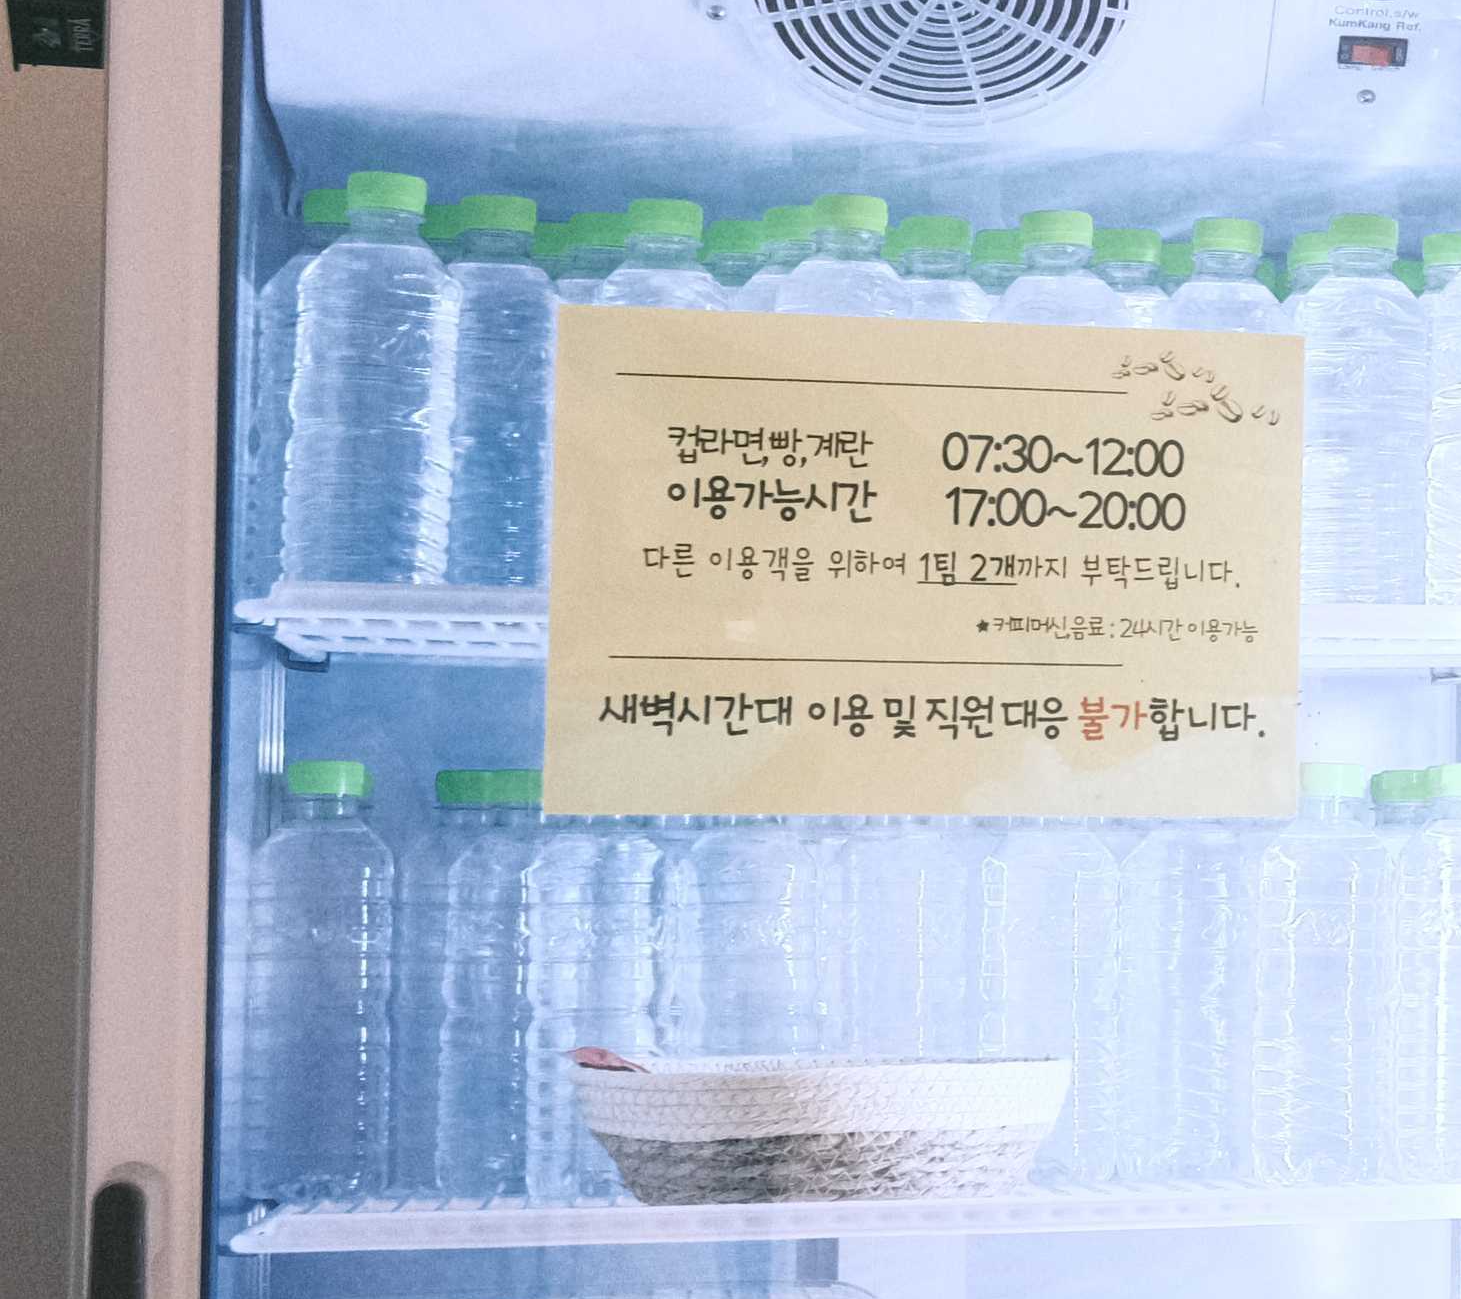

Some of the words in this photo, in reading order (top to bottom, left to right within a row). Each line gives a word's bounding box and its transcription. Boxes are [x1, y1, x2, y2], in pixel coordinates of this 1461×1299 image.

[1328, 17, 1391, 31] KumKang
[941, 431, 1185, 478] 07:30~12:00
[667, 475, 878, 524] 이용가능시간
[944, 486, 1187, 532] 17:00~20:00
[643, 543, 695, 578] 다른
[709, 546, 815, 582] 이용객을
[827, 549, 906, 579] 위하여
[919, 551, 956, 586] 1팀
[969, 553, 1067, 583] 2개까지
[1080, 554, 1240, 590] 부탁드립니다.
[1119, 617, 1183, 642] 24시간
[1187, 620, 1260, 643] 이용가능
[598, 691, 794, 737] 새벽시간대
[807, 694, 875, 738] 이용
[882, 694, 917, 740] 및
[926, 694, 995, 741] 직원
[1000, 696, 1069, 741] 대응
[1076, 695, 1266, 743] 불가합니다.
